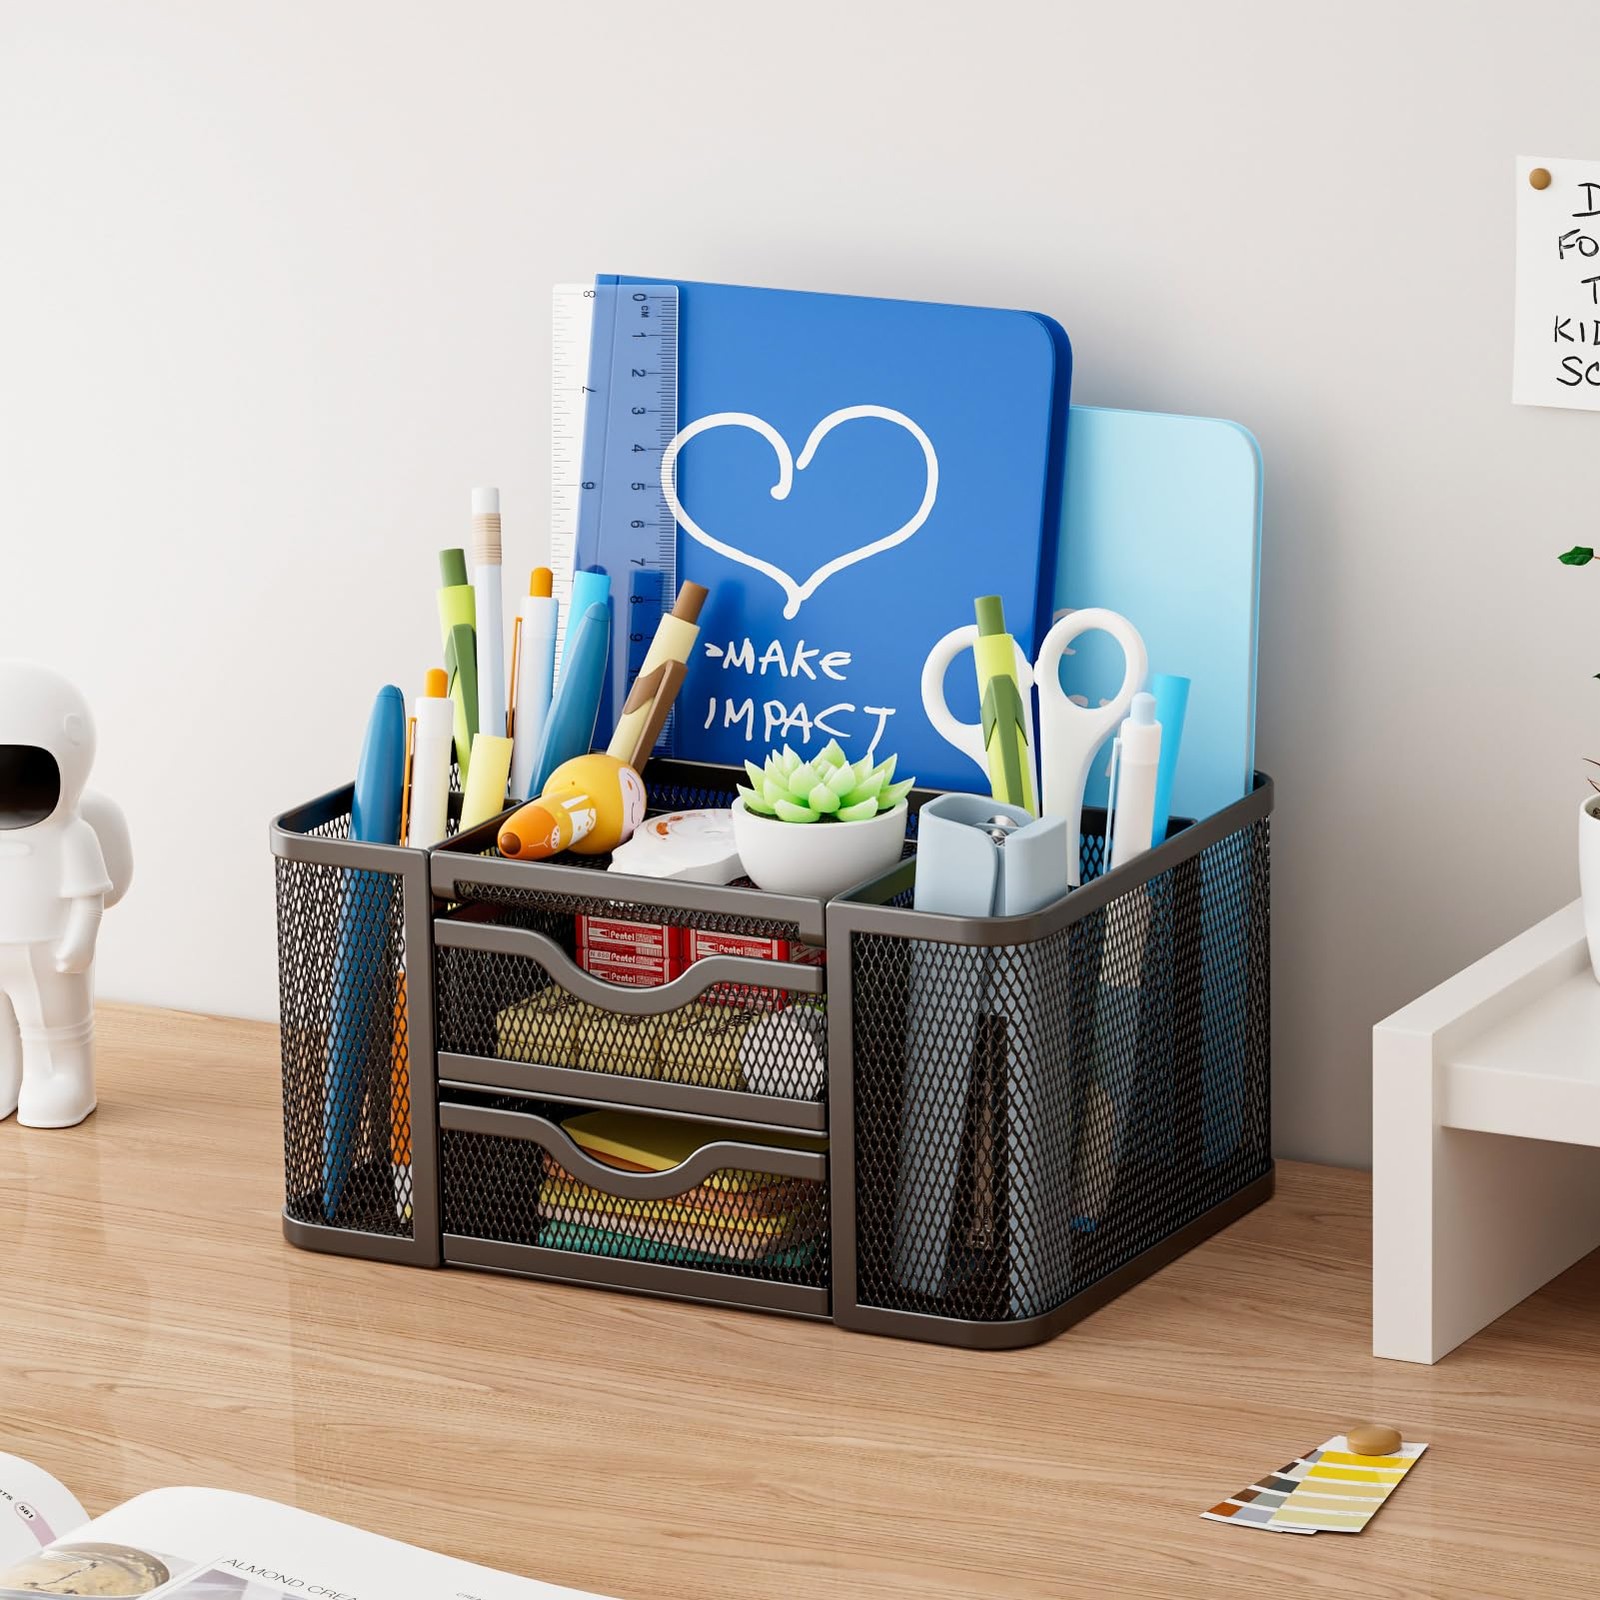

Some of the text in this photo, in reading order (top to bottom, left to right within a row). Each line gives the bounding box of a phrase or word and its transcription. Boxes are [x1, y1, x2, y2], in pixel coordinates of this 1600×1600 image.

[1559, 228, 1599, 260] FO
[583, 290, 596, 298] 8
[1581, 276, 1600, 304] T
[632, 293, 647, 302] 0
[631, 369, 646, 378] 2
[582, 386, 597, 394] 7
[631, 407, 646, 415] 3
[631, 444, 646, 454] 4
[631, 482, 645, 491] 5
[631, 519, 645, 529] 6
[630, 558, 645, 567] 7
[630, 595, 643, 604] 8
[630, 633, 643, 643] 9
[704, 697, 896, 757] IMPACT
[610, 930, 635, 941] Pentel
[719, 944, 744, 955] Pentel
[611, 952, 636, 963] Pentel
[611, 972, 636, 983] Pentel
[18, 1505, 34, 1519] 561
[222, 1558, 305, 1589] ALMOND
